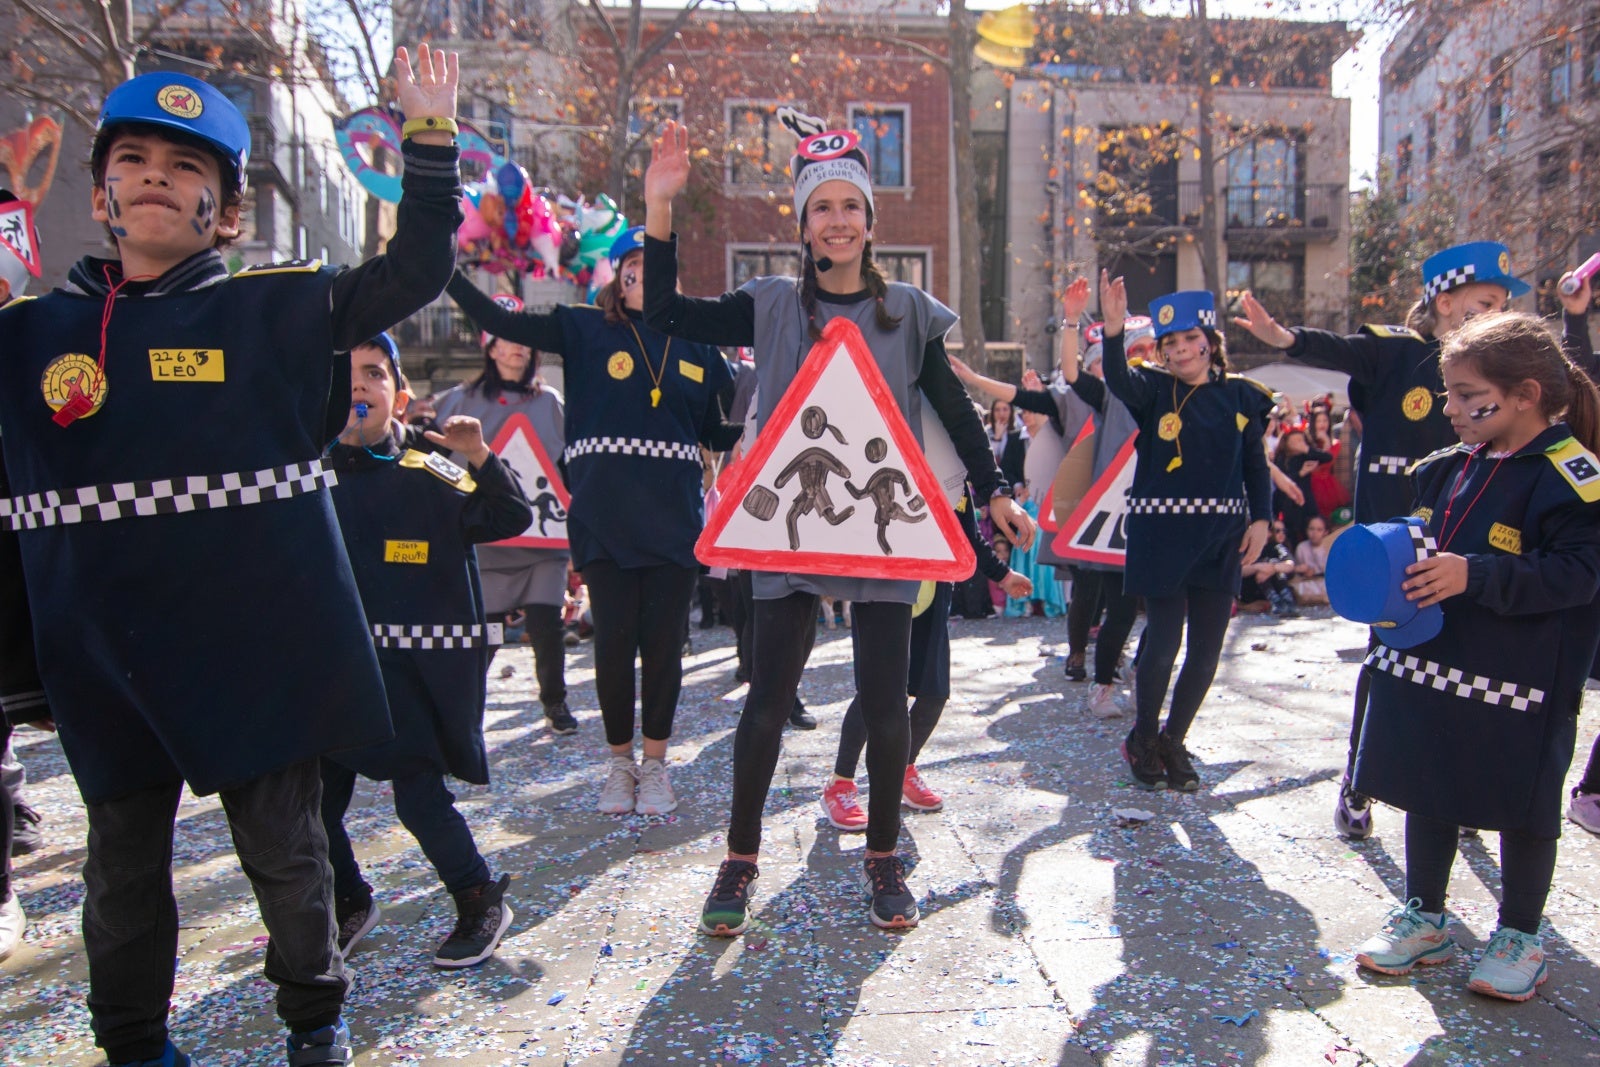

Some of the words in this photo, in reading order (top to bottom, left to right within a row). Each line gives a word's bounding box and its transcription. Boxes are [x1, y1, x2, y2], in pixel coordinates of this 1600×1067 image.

[811, 135, 844, 153] 30
[177, 351, 186, 363] 6
[158, 365, 197, 377] LEO
